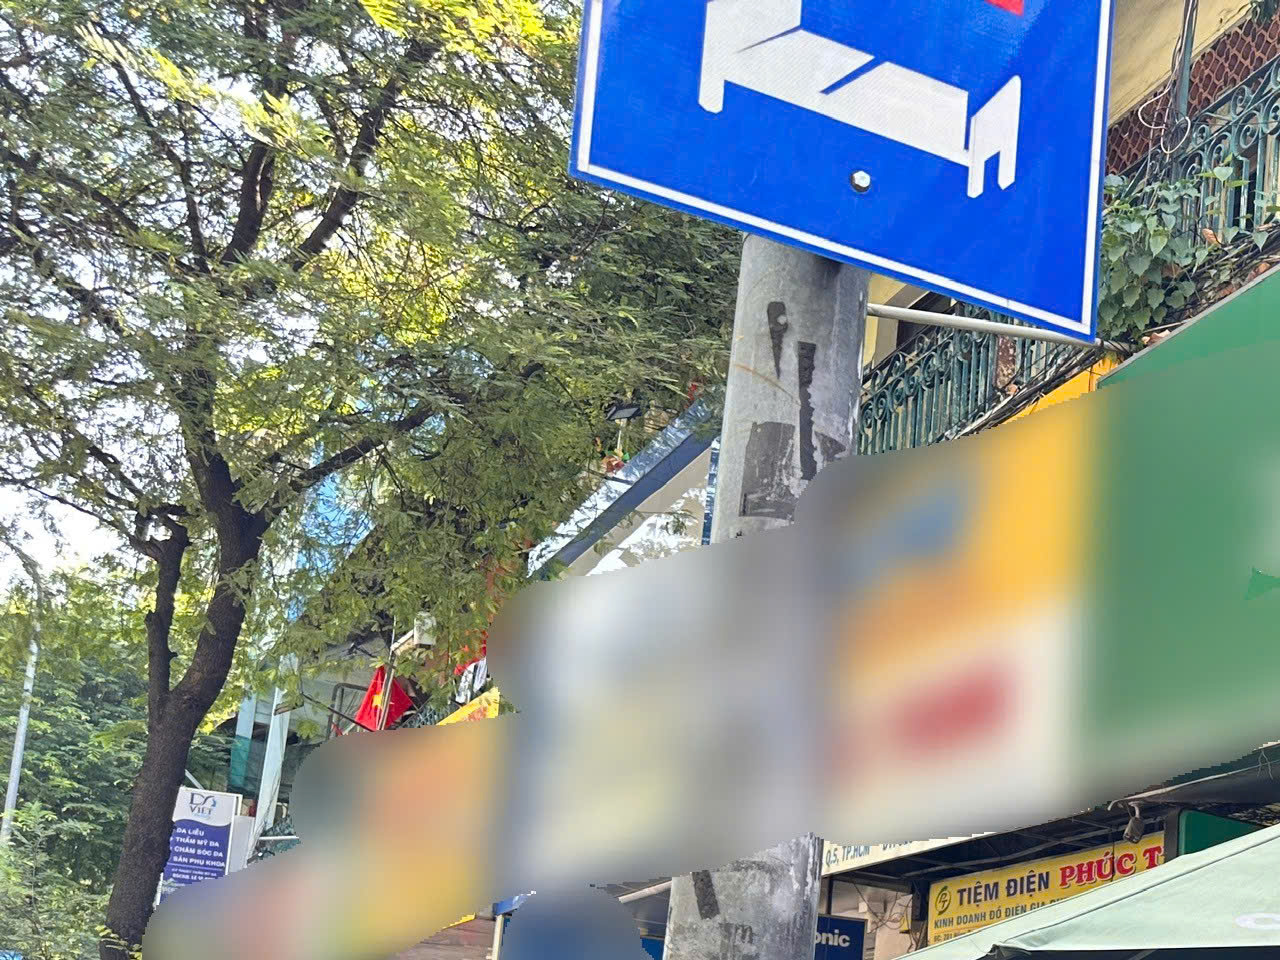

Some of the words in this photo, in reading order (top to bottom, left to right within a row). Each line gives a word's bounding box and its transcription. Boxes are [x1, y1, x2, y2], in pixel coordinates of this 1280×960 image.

[957, 881, 999, 908] TIỆM
[1006, 870, 1050, 897] ĐIỆN
[1058, 852, 1136, 888] PHÚC
[934, 918, 954, 929] KINH
[956, 912, 986, 925] DOANH
